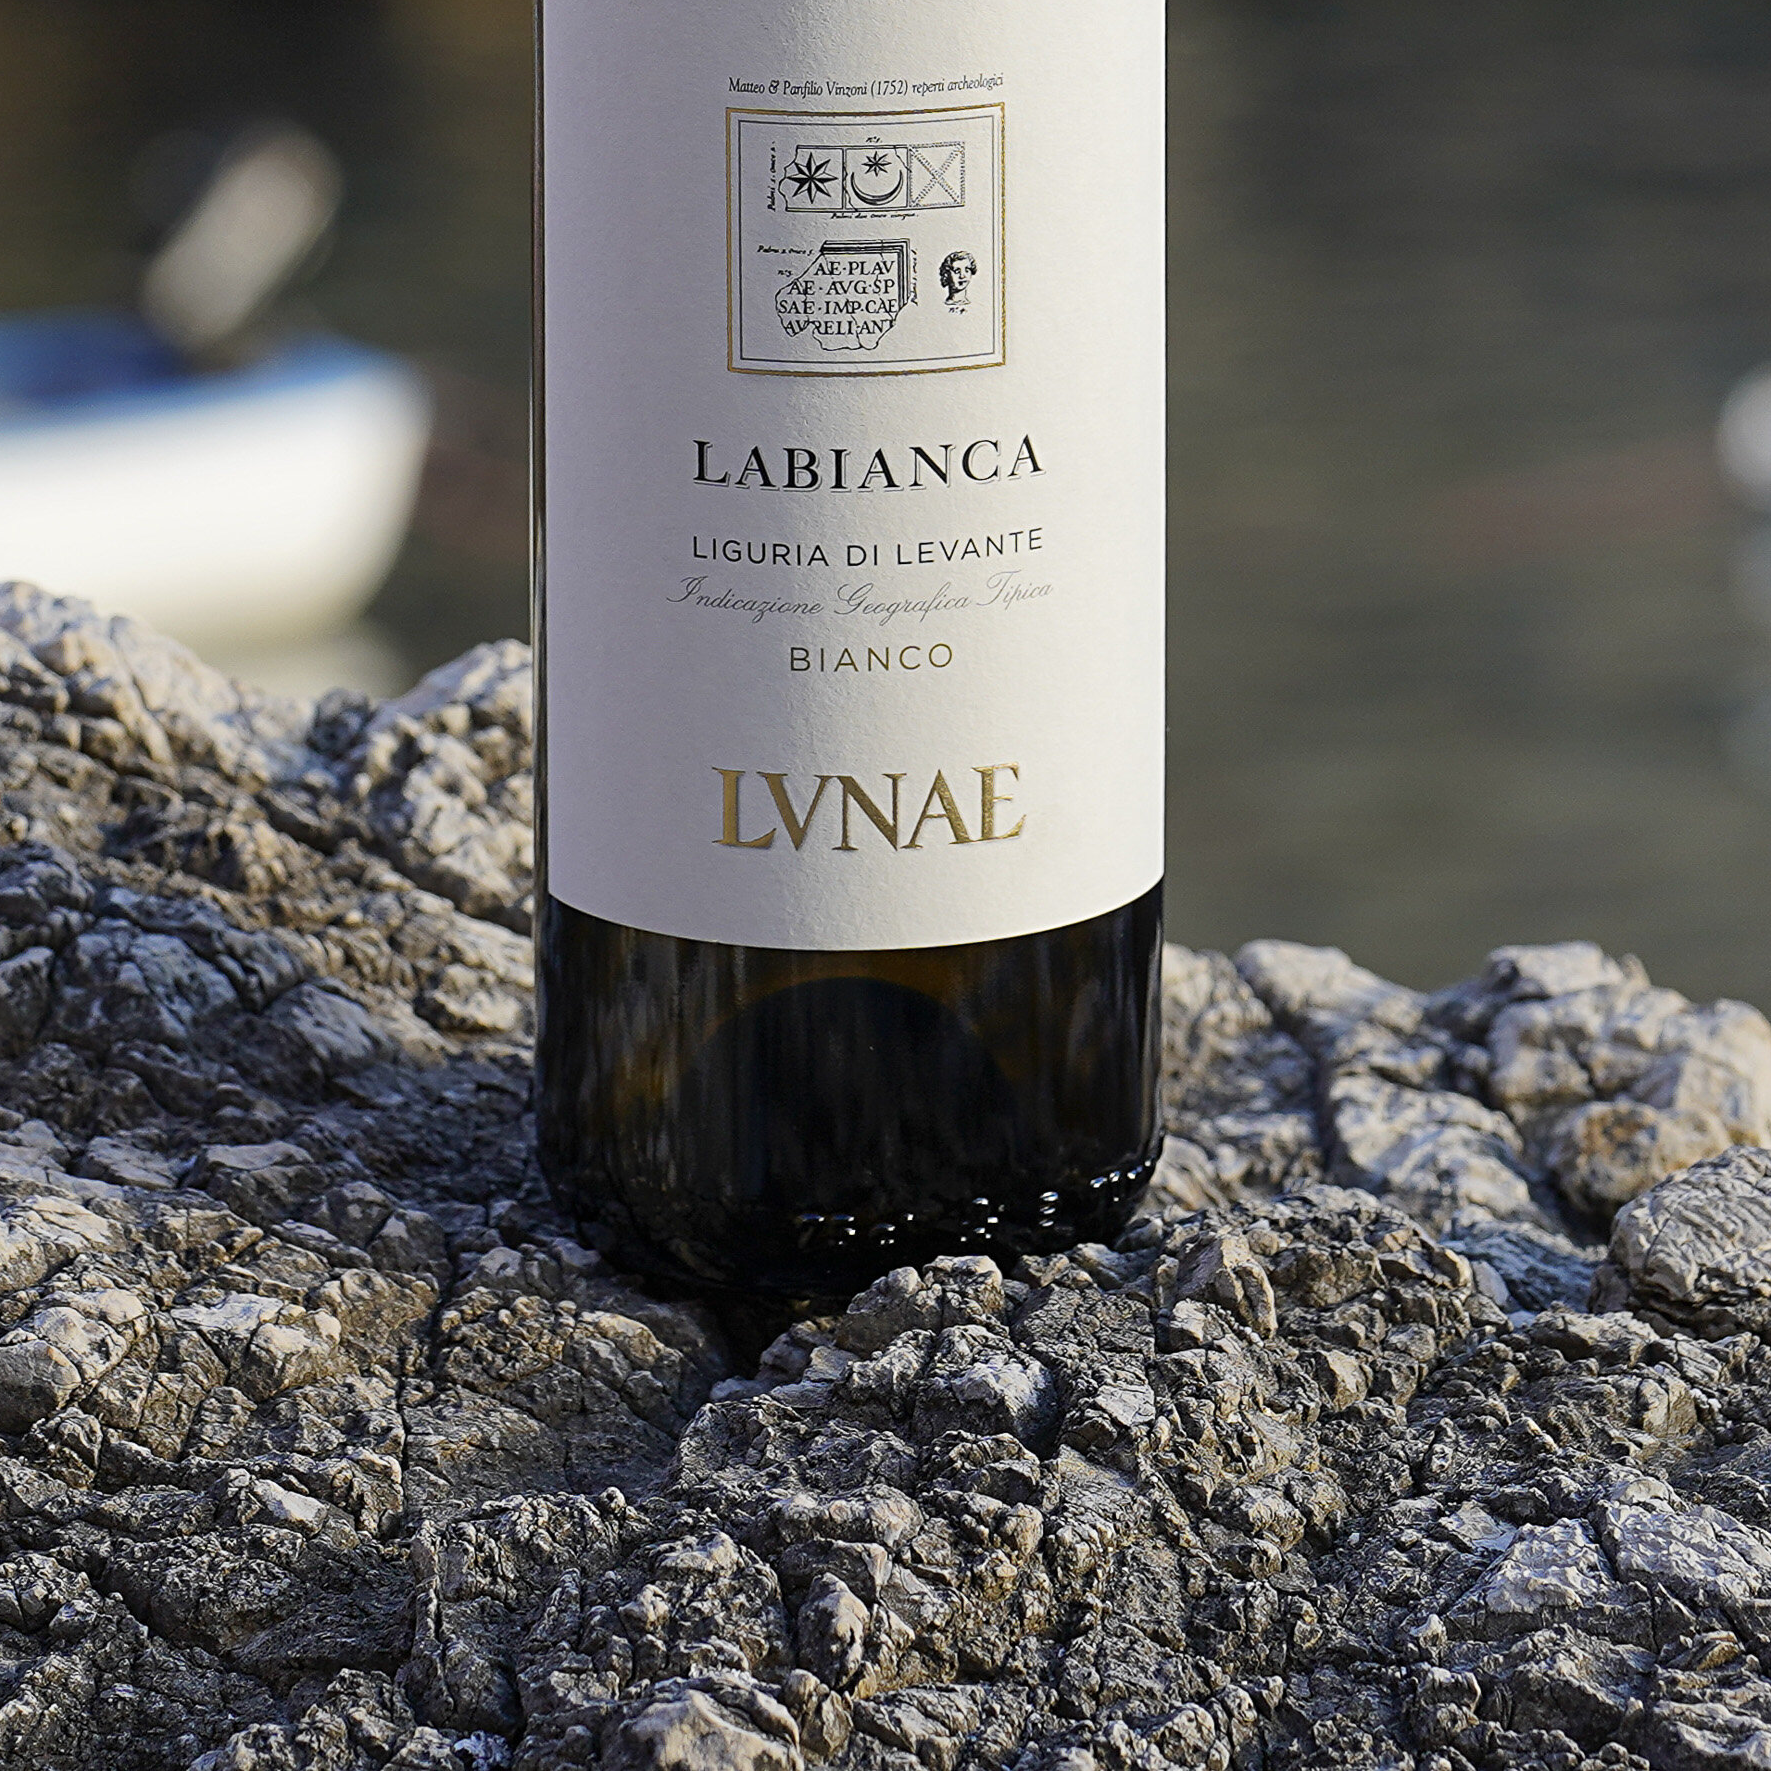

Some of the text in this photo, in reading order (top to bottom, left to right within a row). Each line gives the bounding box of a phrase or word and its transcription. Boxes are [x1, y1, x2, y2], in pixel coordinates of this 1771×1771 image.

[728, 72, 1005, 100] Matteo & Panfilio Vinzoni (1752) reperti archeologici
[692, 434, 1046, 492] LABIANCA
[692, 528, 1043, 567] LIGURIA DI LEVANTE
[666, 569, 1054, 627] Indicazione Geografica Tipica
[790, 643, 953, 673] BIANCO
[712, 762, 1027, 852] LVNAE
